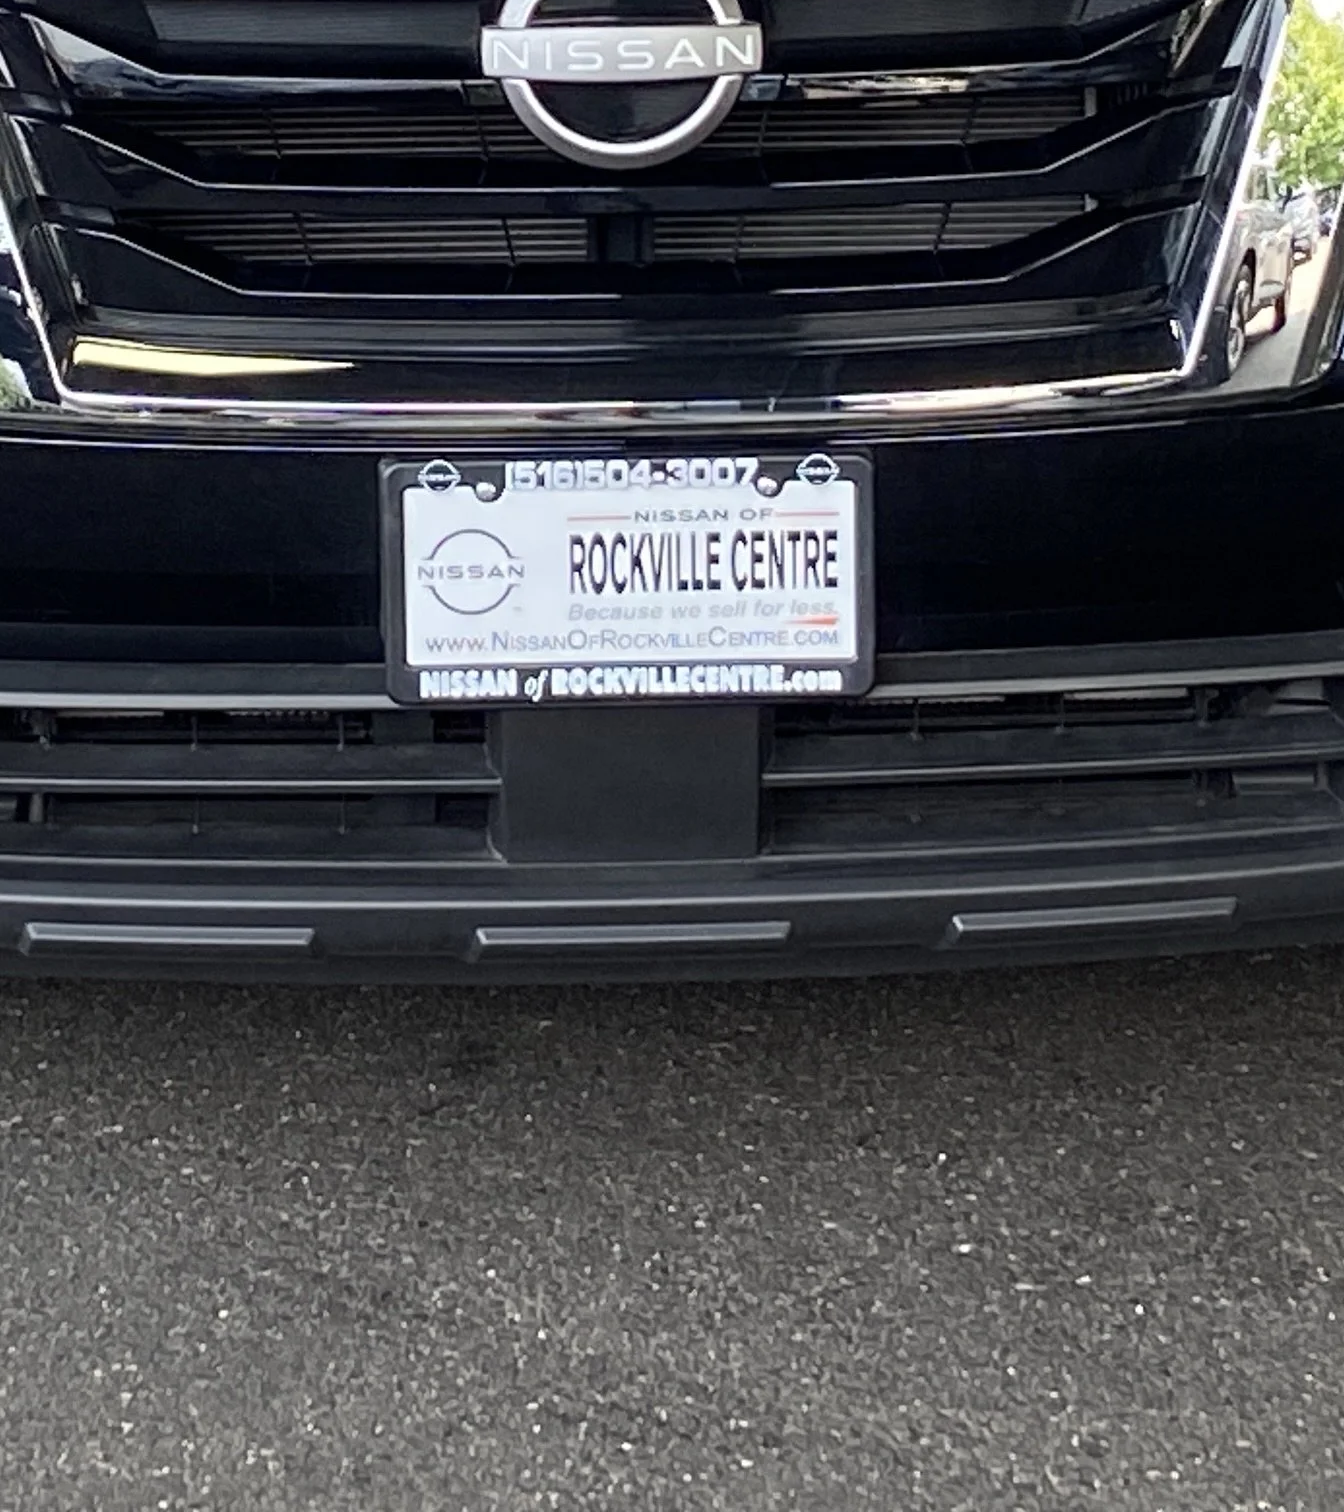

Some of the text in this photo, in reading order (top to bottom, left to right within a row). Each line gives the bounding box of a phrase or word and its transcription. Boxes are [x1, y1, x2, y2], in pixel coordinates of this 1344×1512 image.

[491, 34, 757, 71] NISSAN
[506, 457, 759, 491] (516)504-3007
[634, 508, 774, 523] NISSAN OF
[417, 564, 525, 580] NISSAN
[568, 529, 839, 595] ROCKVILLE CENTRE
[568, 603, 663, 622] Because
[671, 605, 702, 620] we
[709, 600, 746, 619] sell
[753, 600, 786, 618] for
[419, 664, 843, 702] NISSAN of ROCKVILLECENTRE.com
